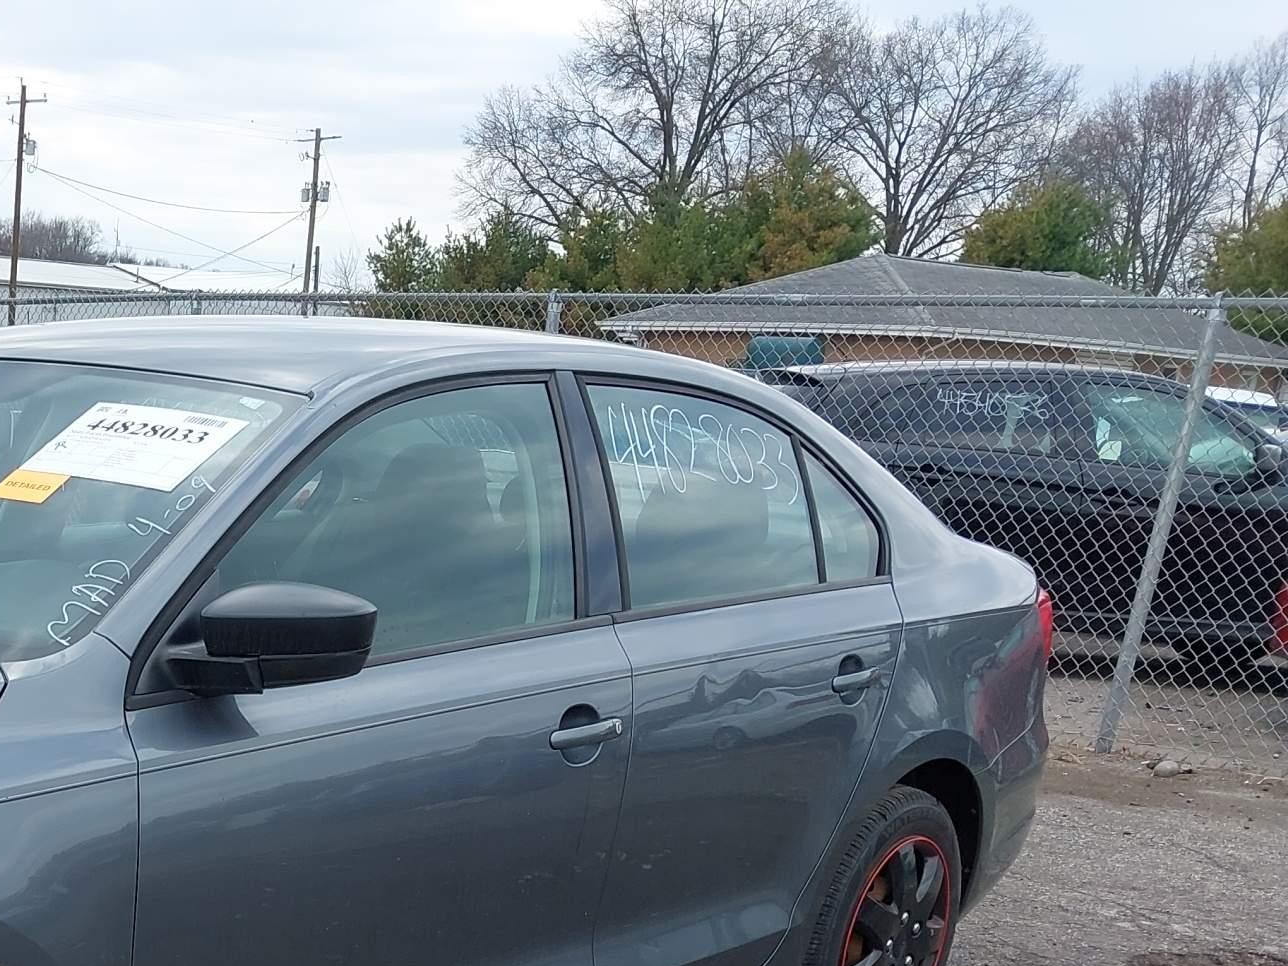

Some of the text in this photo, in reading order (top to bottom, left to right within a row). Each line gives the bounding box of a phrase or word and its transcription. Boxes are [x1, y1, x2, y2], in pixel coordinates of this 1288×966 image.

[86, 416, 210, 445] 44828033
[607, 402, 799, 505] 44828033
[5, 479, 51, 492] DETAILED
[127, 474, 217, 536] 4-09
